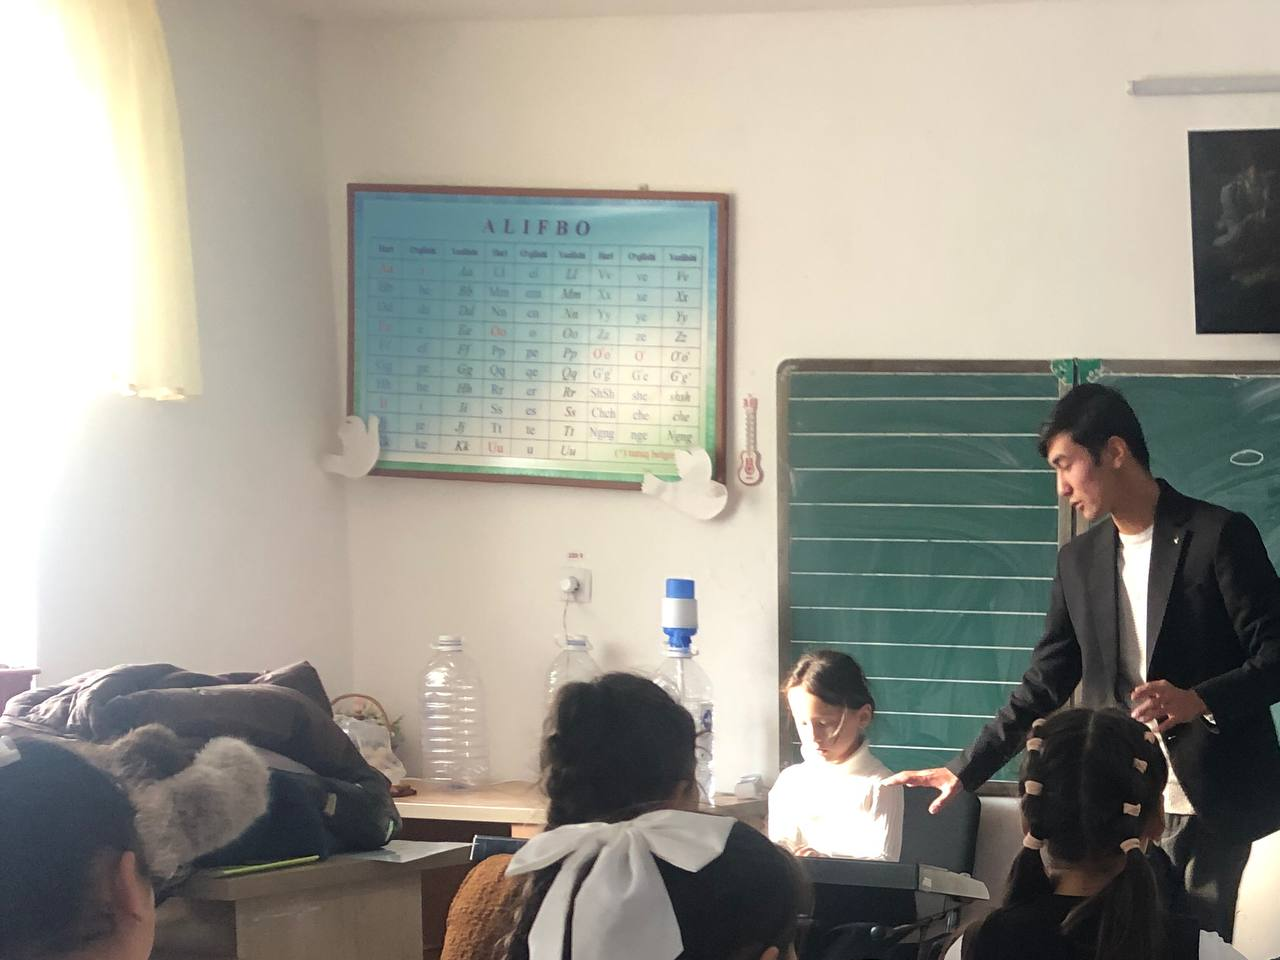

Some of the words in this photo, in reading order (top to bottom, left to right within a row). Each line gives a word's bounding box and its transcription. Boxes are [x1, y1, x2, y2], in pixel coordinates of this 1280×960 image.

[482, 218, 591, 236] ALIFBO
[490, 403, 503, 415] Ss
[564, 407, 576, 417] Ss
